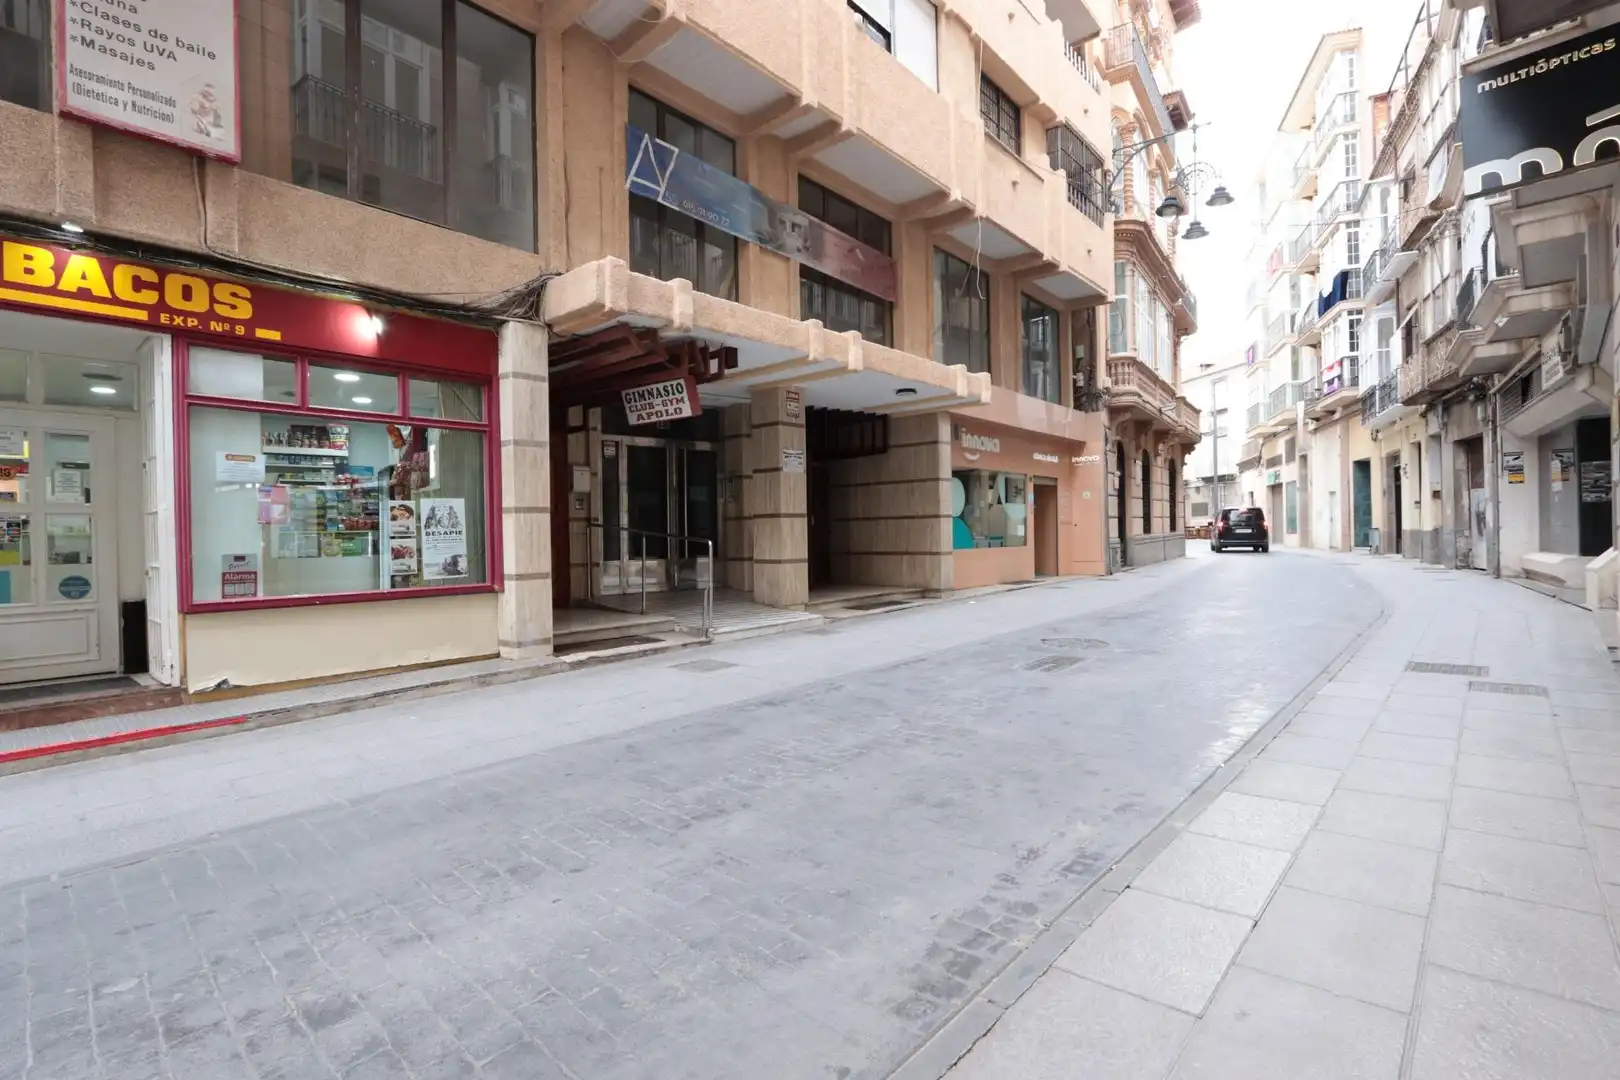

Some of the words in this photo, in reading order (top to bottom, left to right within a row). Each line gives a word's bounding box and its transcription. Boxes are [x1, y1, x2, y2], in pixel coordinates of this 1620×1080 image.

[80, 1, 142, 33] Clases
[148, 28, 169, 43] de
[175, 37, 216, 60] baile
[80, 18, 136, 47] Rayos
[143, 40, 177, 62] UVA
[80, 35, 156, 71] Masajes
[69, 63, 125, 92] Asesoramiento
[127, 81, 177, 108] Personalizado
[122, 99, 128, 112] y
[2, 240, 253, 320] BACOS
[160, 312, 202, 329] EXP.
[235, 324, 245, 336] 9
[624, 382, 685, 405] GIMNASIO
[628, 396, 686, 414] CLUB-GYM
[636, 407, 683, 422] APOLO
[1071, 454, 1100, 464] innova
